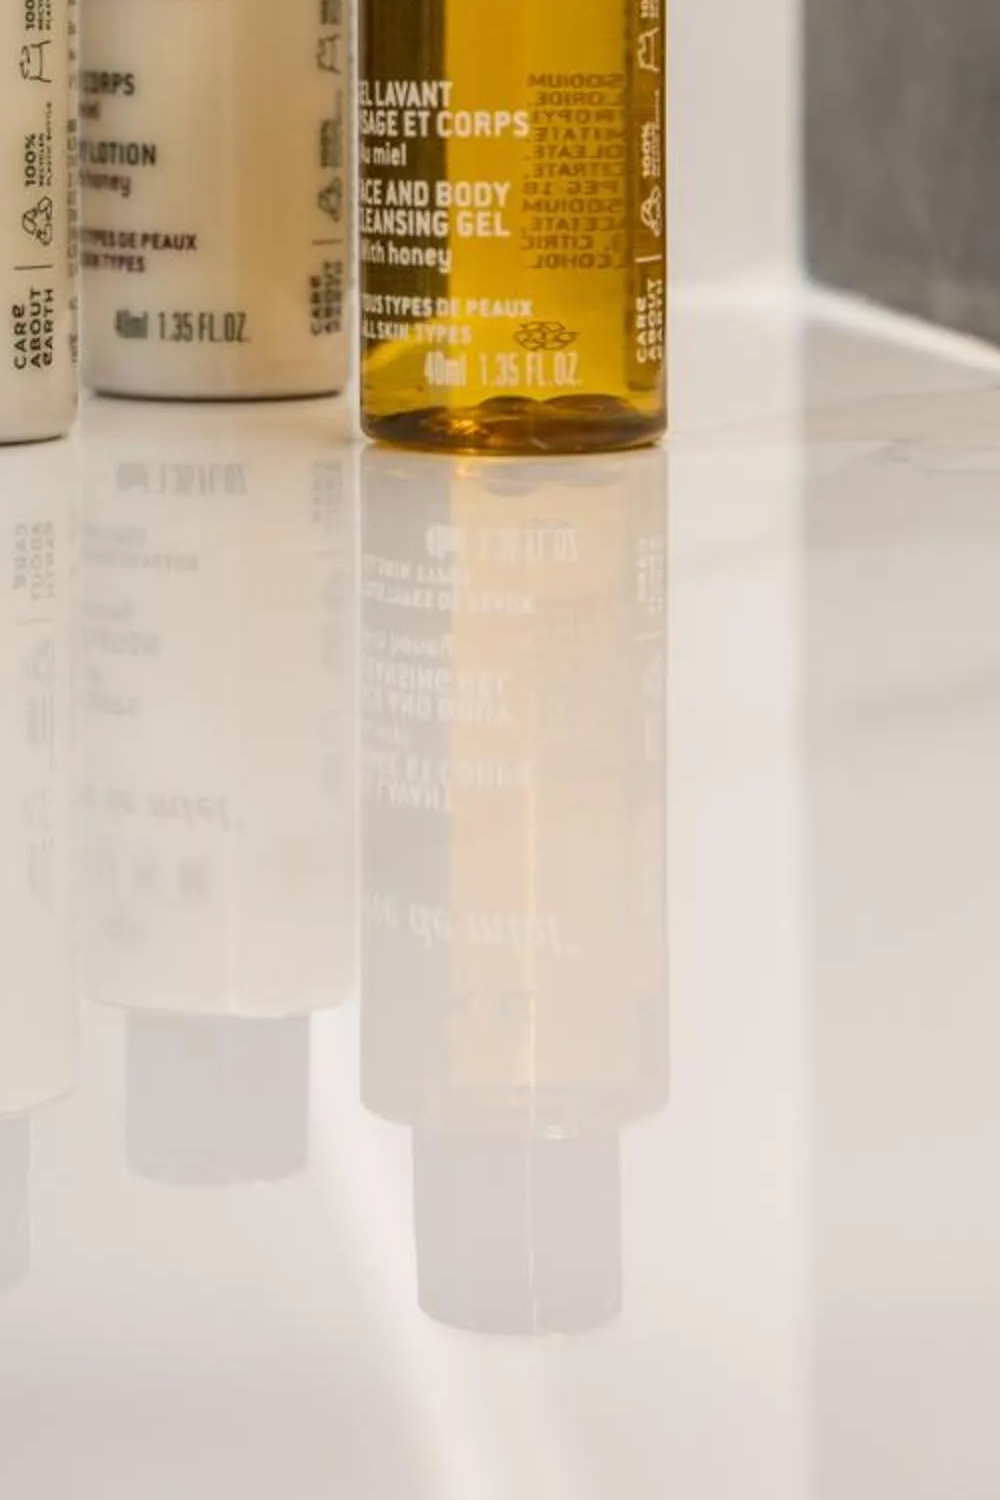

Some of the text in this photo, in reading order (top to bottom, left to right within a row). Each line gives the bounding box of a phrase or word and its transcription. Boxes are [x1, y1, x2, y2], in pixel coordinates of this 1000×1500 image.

[359, 80, 454, 108] EL LAVANT
[361, 109, 531, 139] SAGE ET CORPS
[24, 133, 36, 187] 100%
[373, 141, 407, 167] miel
[386, 179, 429, 207] AND
[435, 180, 512, 208] BODY
[360, 207, 512, 238] LEANSING GEL
[141, 232, 198, 251] PEAUX
[388, 240, 453, 274] honey
[385, 296, 433, 317] TYPES
[466, 299, 534, 318] PEAUX
[29, 285, 42, 369] ABOUT
[158, 311, 193, 341] 1.35
[413, 323, 473, 345] TYPES
[424, 350, 467, 387] 40ml
[481, 351, 520, 388] 1.35
